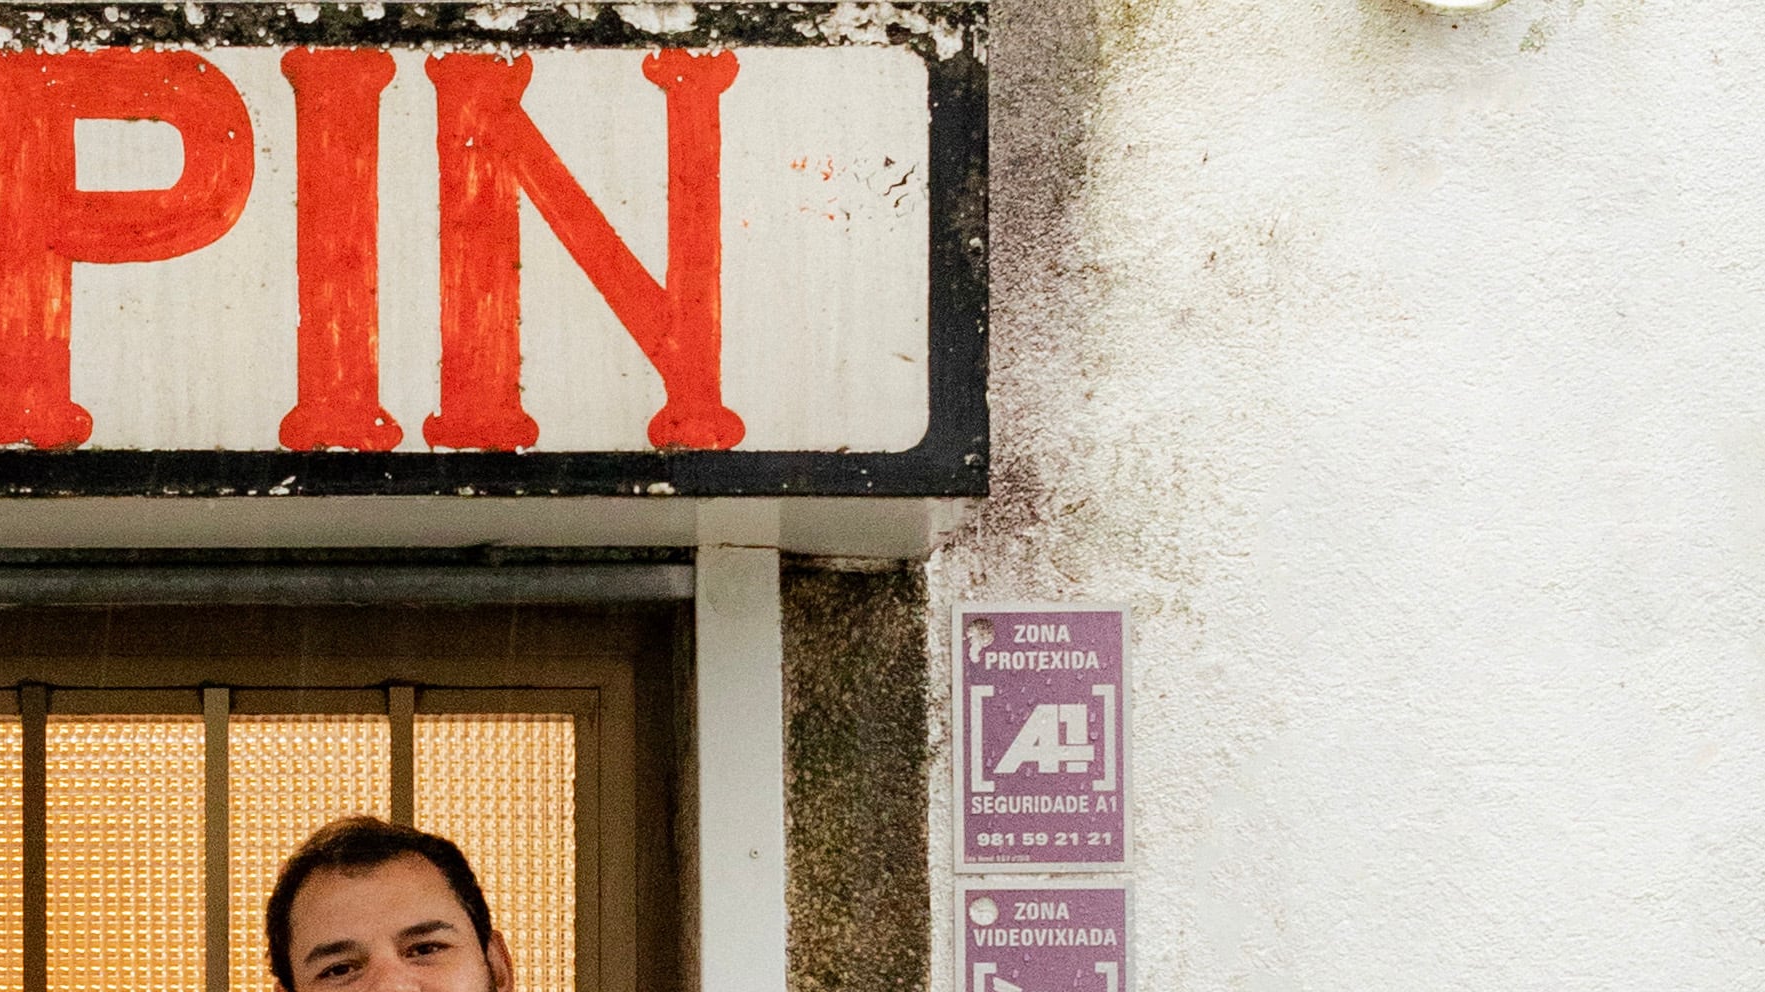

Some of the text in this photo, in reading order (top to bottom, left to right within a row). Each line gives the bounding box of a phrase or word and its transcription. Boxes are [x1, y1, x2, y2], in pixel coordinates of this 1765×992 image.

[1014, 624, 1071, 644] ZONA
[986, 651, 1099, 671] PROTEXIDA
[971, 795, 1118, 815] SEGURIDADE A1
[976, 831, 1112, 847] 981 59 21 21
[1014, 902, 1070, 920] ZONA
[973, 928, 1118, 947] VIDEOVIXIADA
